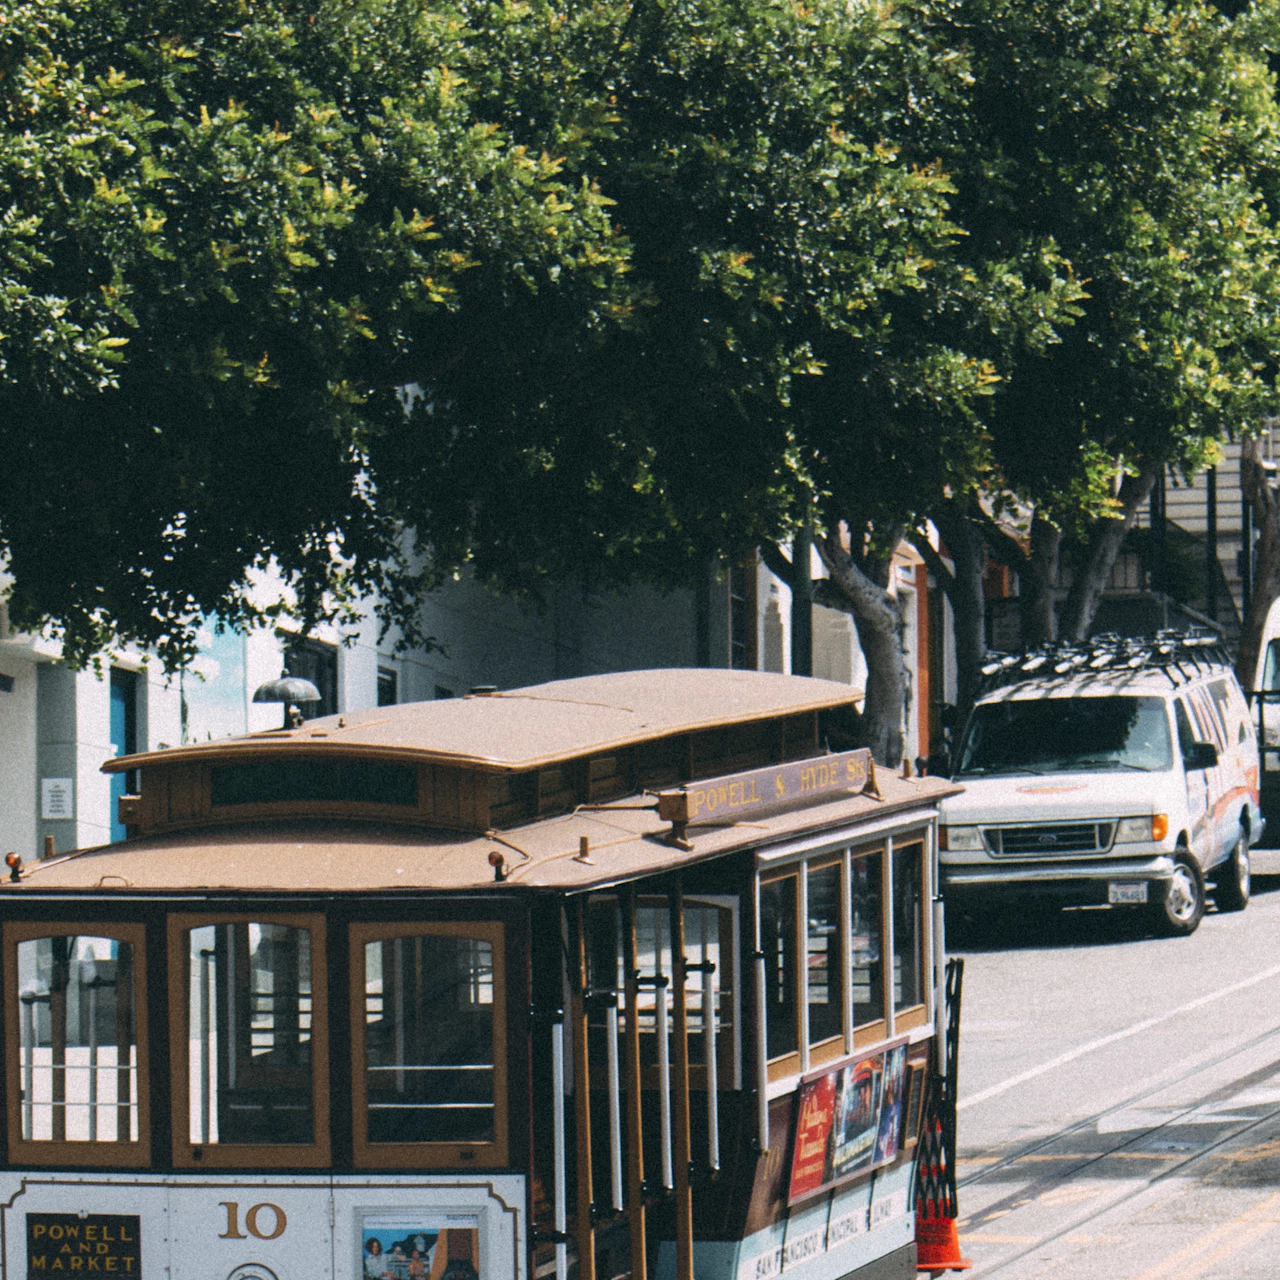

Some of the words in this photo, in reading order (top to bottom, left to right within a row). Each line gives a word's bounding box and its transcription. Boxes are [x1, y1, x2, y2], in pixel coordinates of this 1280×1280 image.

[695, 778, 762, 815] POWELL
[800, 761, 840, 792] HYDE
[32, 1224, 133, 1241] POWELL
[218, 1201, 287, 1240] 10
[59, 1242, 110, 1254] AND
[755, 1255, 771, 1280] SAN
[774, 1230, 819, 1271] FANCISCO
[31, 1255, 136, 1272] MARKET
